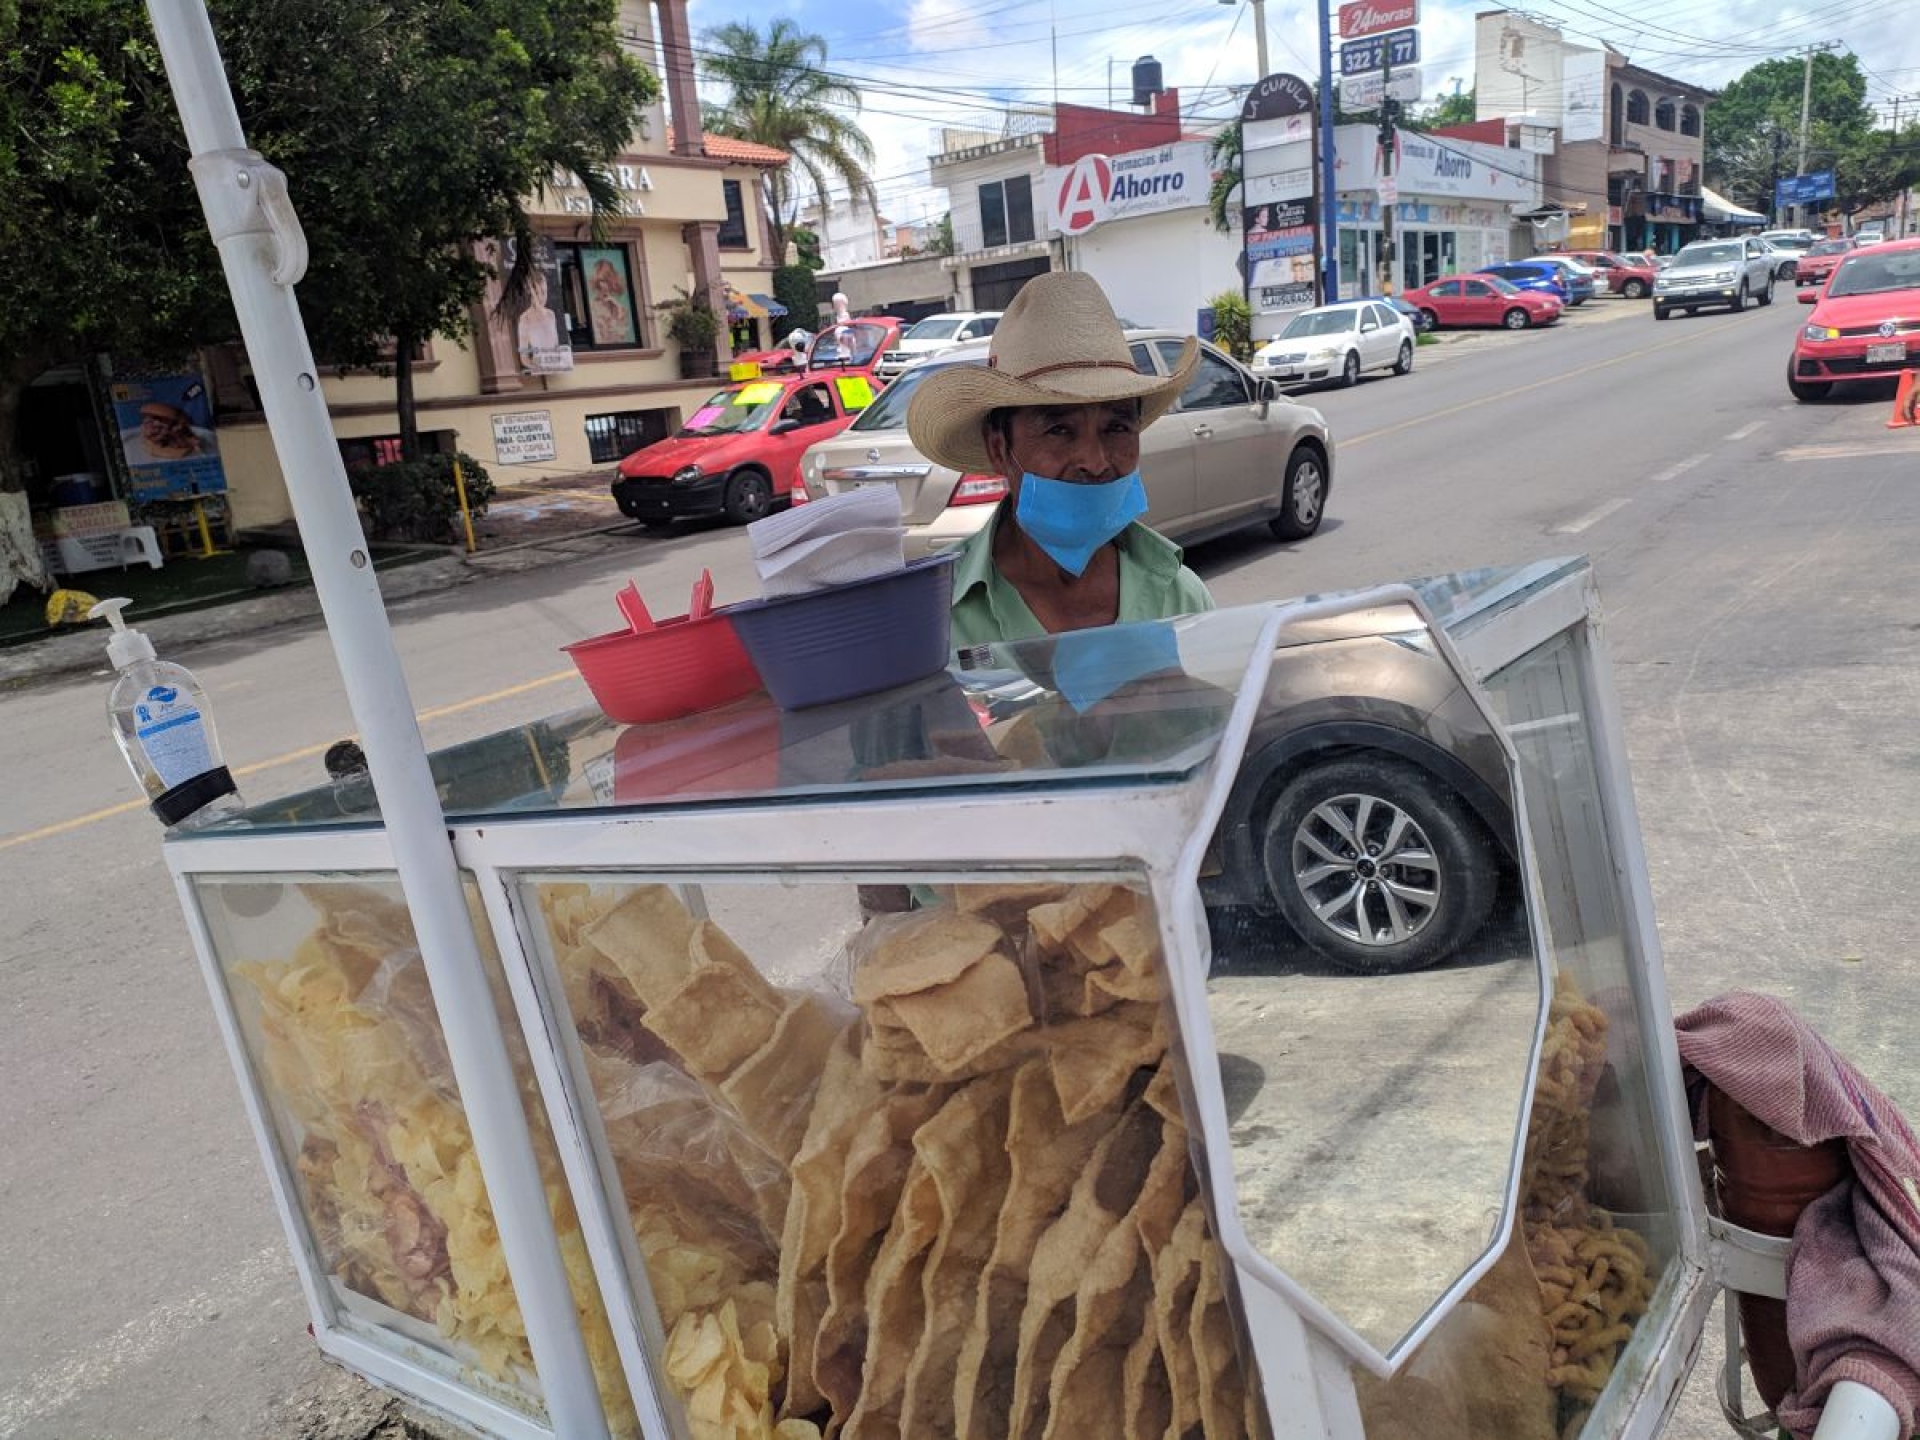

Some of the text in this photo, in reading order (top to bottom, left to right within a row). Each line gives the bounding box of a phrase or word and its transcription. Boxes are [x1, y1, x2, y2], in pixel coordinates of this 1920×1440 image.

[1345, 50, 1371, 73] 322
[1394, 42, 1412, 62] 77
[1244, 78, 1308, 119] LA CUPULA
[1111, 147, 1174, 173] Farmacias del
[1434, 149, 1472, 179] Ahorro
[1110, 171, 1184, 202] Ahorro
[1261, 291, 1314, 308] CLAUSURADO
[496, 433, 551, 444] PARA CLIENTES
[503, 424, 543, 434] EXCLUSIVO
